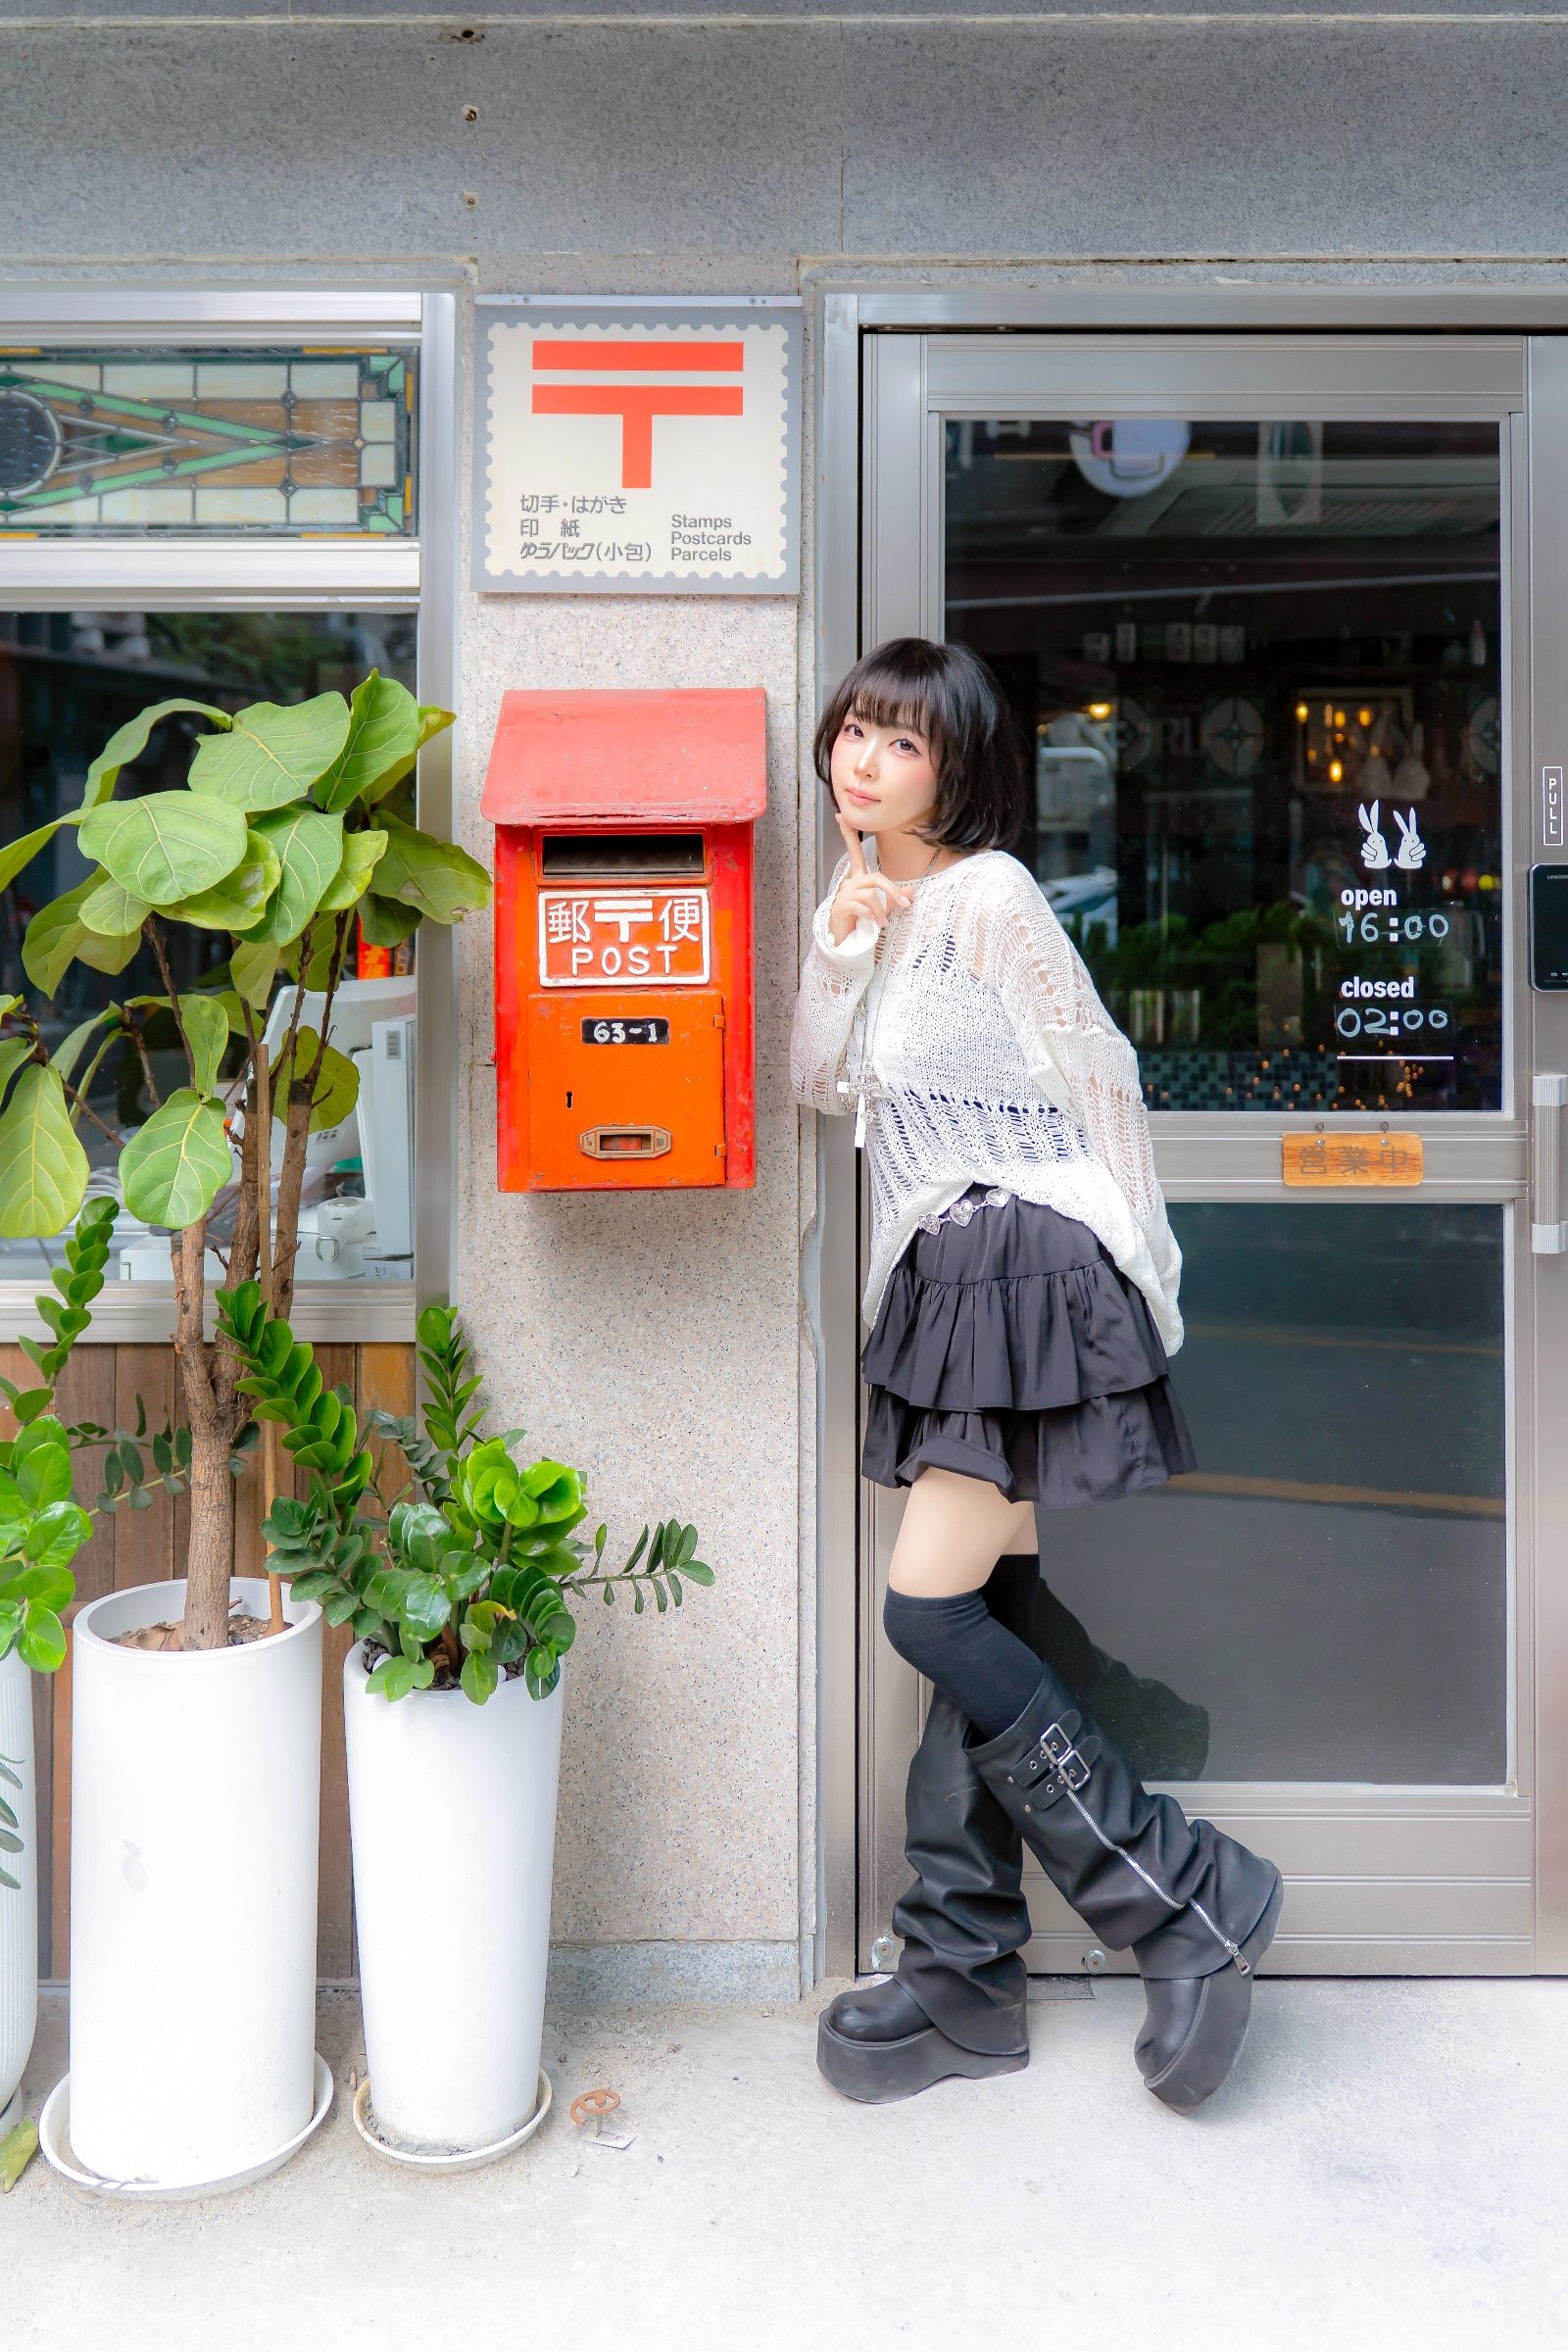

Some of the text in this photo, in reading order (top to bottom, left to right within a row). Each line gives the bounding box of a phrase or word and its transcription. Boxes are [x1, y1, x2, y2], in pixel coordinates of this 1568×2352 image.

[671, 514, 732, 530] Stamps
[670, 530, 752, 545] Postcards
[670, 547, 732, 561] Parcels
[1548, 777, 1558, 834] PULL
[1341, 889, 1397, 910] open
[1339, 910, 1449, 943] 16:00
[571, 945, 678, 976] POST
[1341, 976, 1415, 998] closed
[593, 1021, 658, 1043] 63-1
[1337, 1007, 1448, 1038] 02:00
[1298, 1145, 1408, 1175] 営業中
